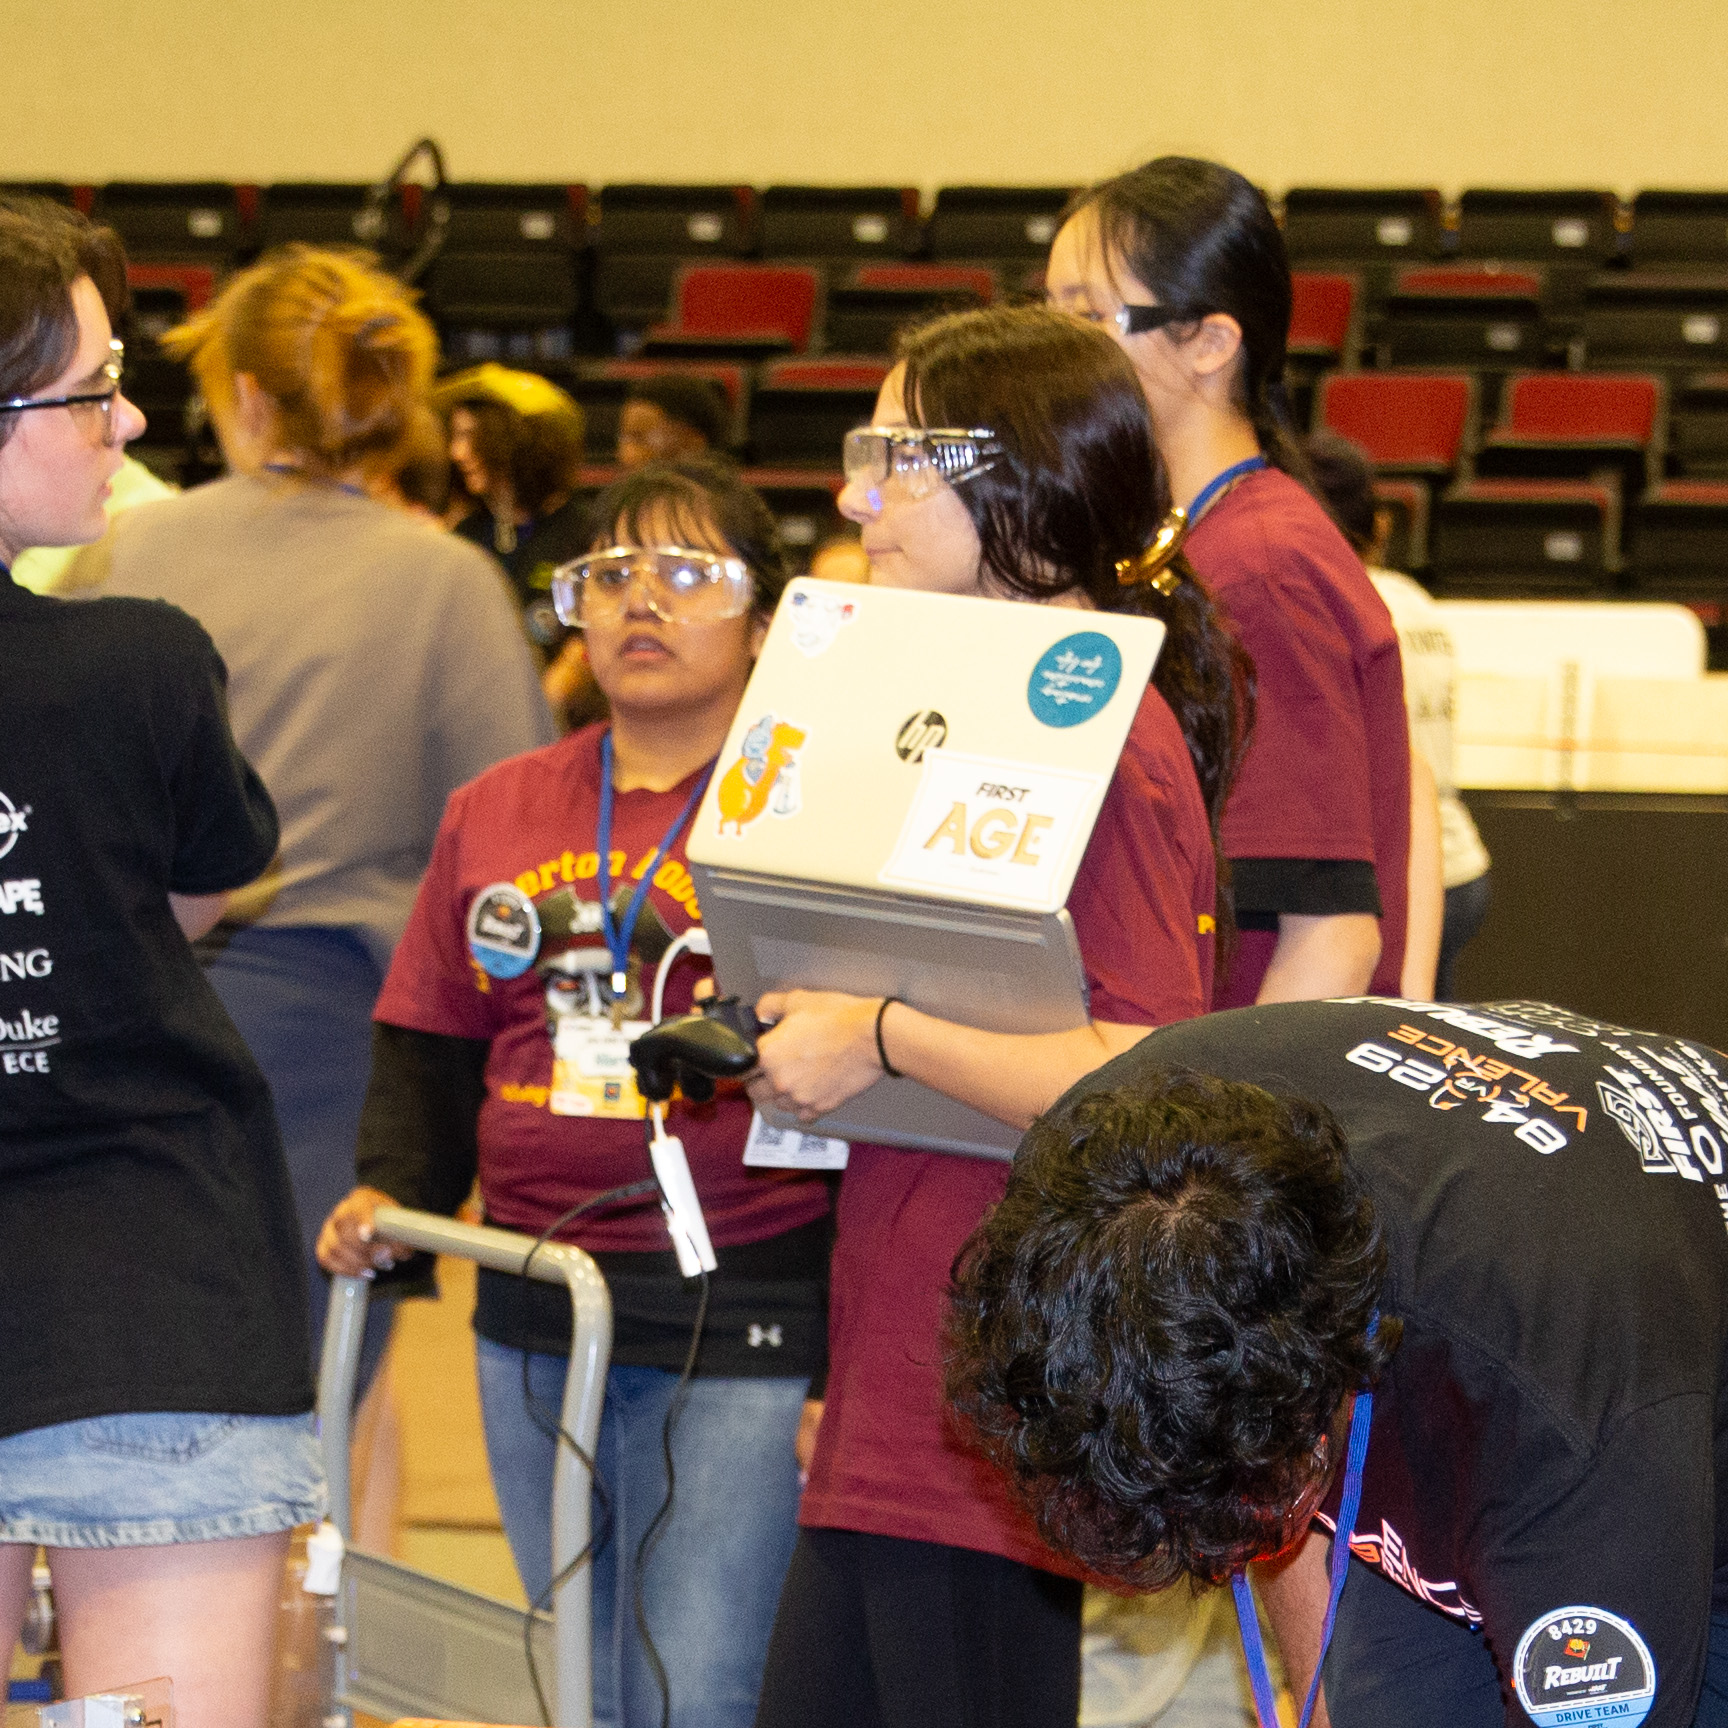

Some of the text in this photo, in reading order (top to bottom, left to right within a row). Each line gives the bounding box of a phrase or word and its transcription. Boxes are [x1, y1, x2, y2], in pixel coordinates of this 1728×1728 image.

[897, 710, 946, 764] hp
[976, 782, 1031, 802] FIRST
[922, 801, 1055, 867] AGE
[3, 1052, 51, 1075] ECE
[1387, 1024, 1589, 1133] VALENCE
[1600, 1040, 1699, 1121] FOUNDRY
[1345, 1042, 1568, 1156] 8429
[1453, 1076, 1488, 1096] VR
[1602, 1065, 1704, 1183] FIRST
[1547, 1619, 1598, 1641] 8429
[1544, 1657, 1623, 1690] REBUILT
[1556, 1703, 1630, 1723] DRIVE TEAM
